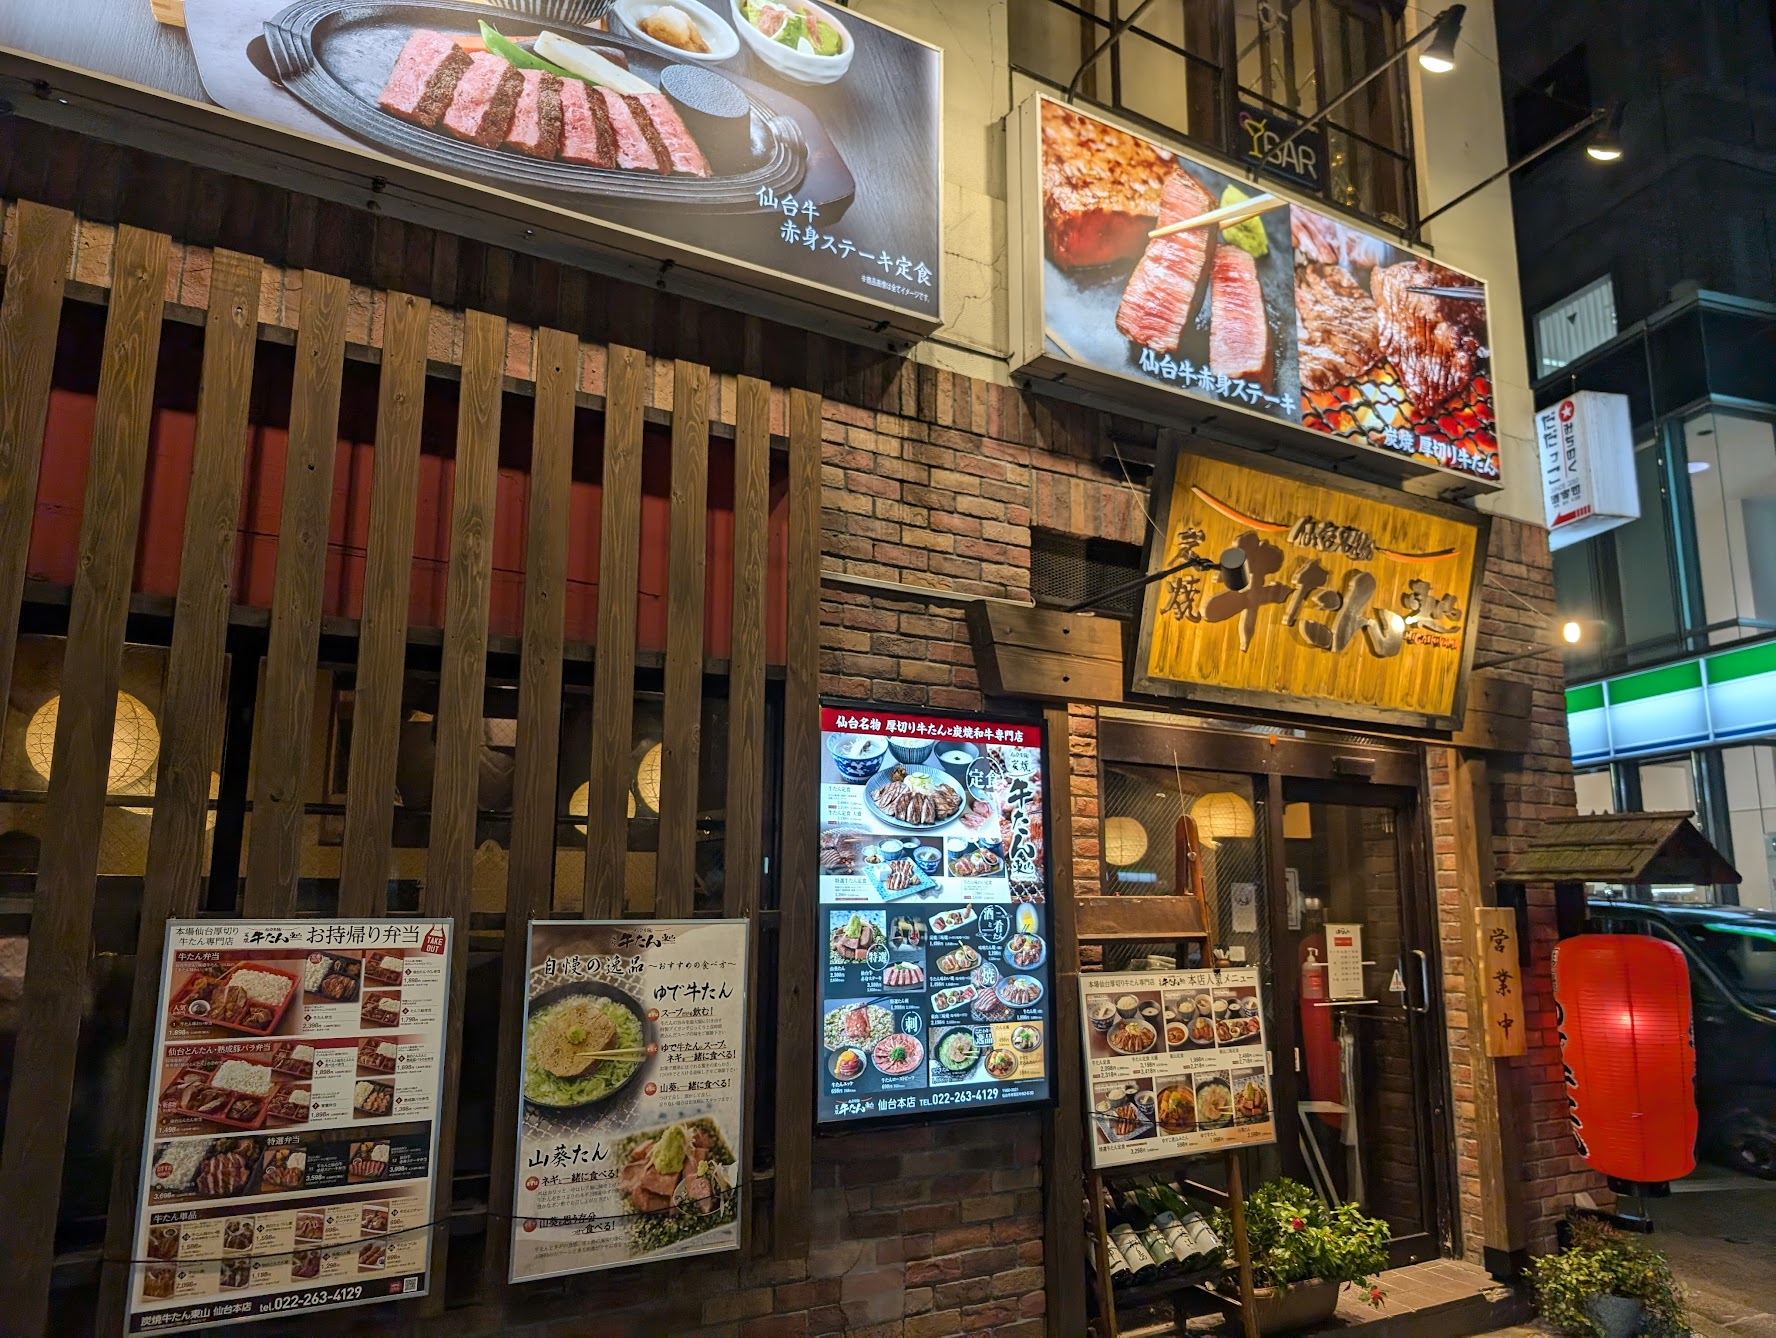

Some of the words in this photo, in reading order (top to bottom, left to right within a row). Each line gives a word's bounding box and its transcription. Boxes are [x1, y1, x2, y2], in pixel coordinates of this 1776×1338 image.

[1263, 131, 1317, 179] BAR
[755, 184, 820, 223] 仙台牛
[780, 219, 933, 287] 赤身ステーキ定食
[1139, 347, 1296, 415] 仙台牛赤身ステーキ
[1383, 425, 1416, 453] 炭焼
[1418, 434, 1499, 476] 厚切り牛たん
[1200, 529, 1404, 658] 牛たん
[835, 715, 881, 731] 仙台名物
[885, 719, 1024, 743] 厚切り牛たんと炭焼和牛専門店
[968, 769, 999, 789] 定食
[1008, 779, 1036, 860] 牛たん
[175, 926, 239, 936] 本場仙台厚切り
[179, 937, 234, 946] 牛たん専門店
[250, 931, 290, 944] 牛たん
[306, 925, 420, 945] お持帰り弁当
[426, 936, 443, 947] TAKE
[618, 932, 661, 949] 牛たん
[178, 952, 220, 961] 牛たん弁当
[426, 944, 440, 954] OUT
[544, 954, 645, 976] 自慢の逸品
[982, 967, 996, 985] 焼
[1489, 926, 1515, 1040] 営業中
[653, 981, 734, 1003] ゆで牛たん
[904, 1015, 918, 1033] 刺
[168, 1043, 271, 1057] 仙台とんたん・熟成豚バラ弁当
[877, 1097, 916, 1111] 仙台本店
[919, 1087, 999, 1107] TEL.022-263-4129
[266, 1135, 300, 1146] 特選弁当
[528, 1142, 609, 1168] 山葵たん
[152, 1210, 198, 1223] 牛たん単品
[141, 1308, 211, 1327] 炭焼牛たん東山
[213, 1301, 252, 1317] 仙台本店
[259, 1286, 363, 1313] tel.022-263-4129
